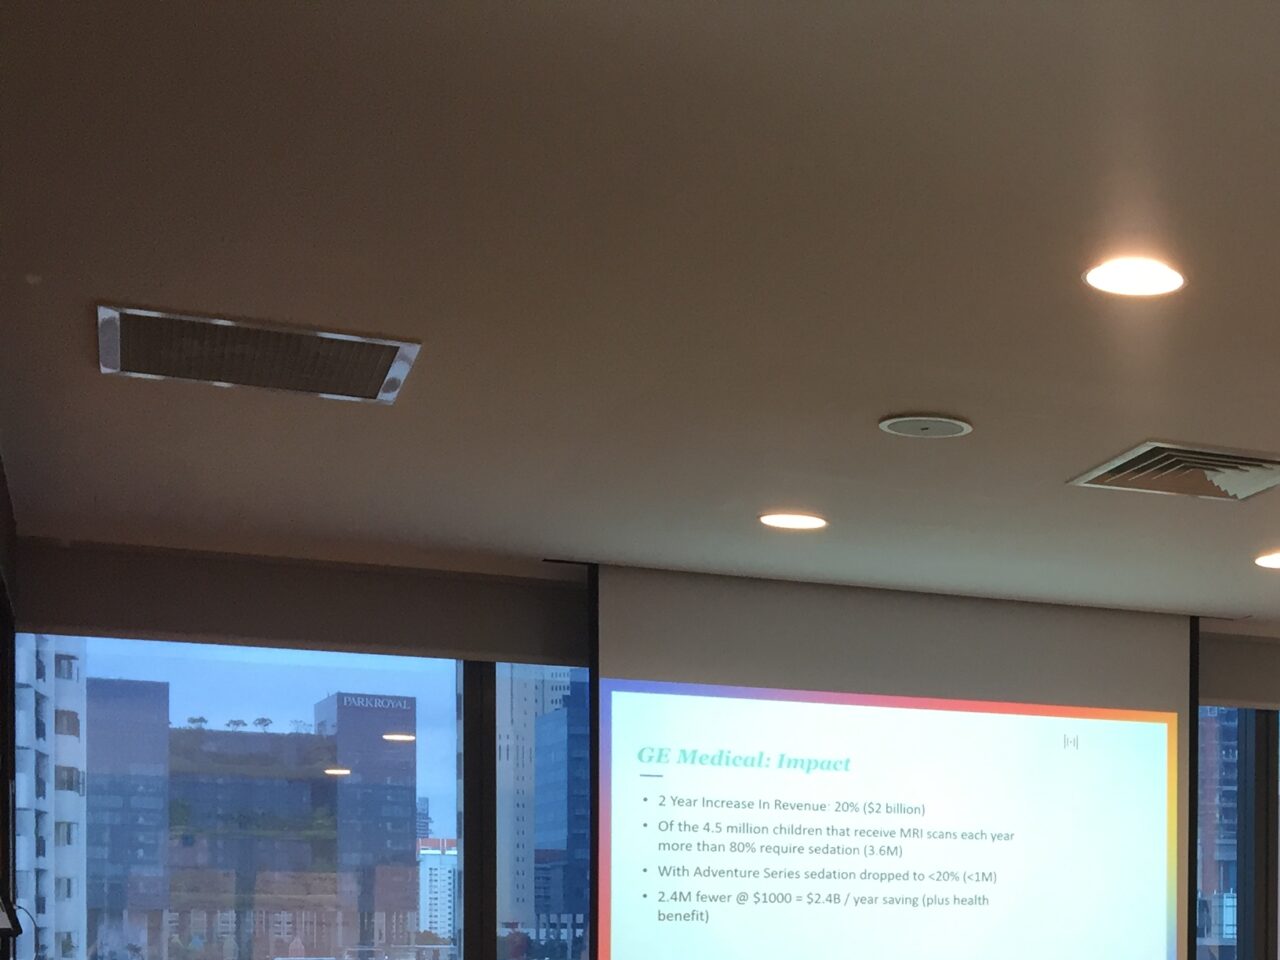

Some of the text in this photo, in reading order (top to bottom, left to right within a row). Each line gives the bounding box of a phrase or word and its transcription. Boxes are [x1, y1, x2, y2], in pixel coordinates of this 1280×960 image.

[343, 696, 411, 710] PARKROYAL
[637, 746, 851, 774] GE Medical: Impact
[658, 795, 666, 806] 2
[670, 796, 698, 807] Year
[702, 797, 755, 809] Increase
[758, 799, 770, 810] In
[834, 801, 860, 813] 20%
[863, 801, 882, 815] ($2
[885, 803, 926, 817] billion)
[658, 820, 1015, 843] Of the 4.5 million children that receive MRI scans each year
[658, 840, 903, 858] more than 80% require sedation (3.6M)
[658, 865, 997, 884] With Adventure Series sedation dropped to <20% (<1M)
[658, 891, 692, 903] 2.4M
[695, 890, 732, 903] fewer
[735, 892, 749, 905] @
[753, 891, 792, 904] $1000
[806, 892, 841, 905] $2.4B
[843, 892, 851, 906] /
[853, 896, 879, 907] year
[882, 894, 919, 908] saving
[922, 894, 950, 908] (plus
[952, 894, 989, 906] health
[658, 909, 709, 924] benefit)
